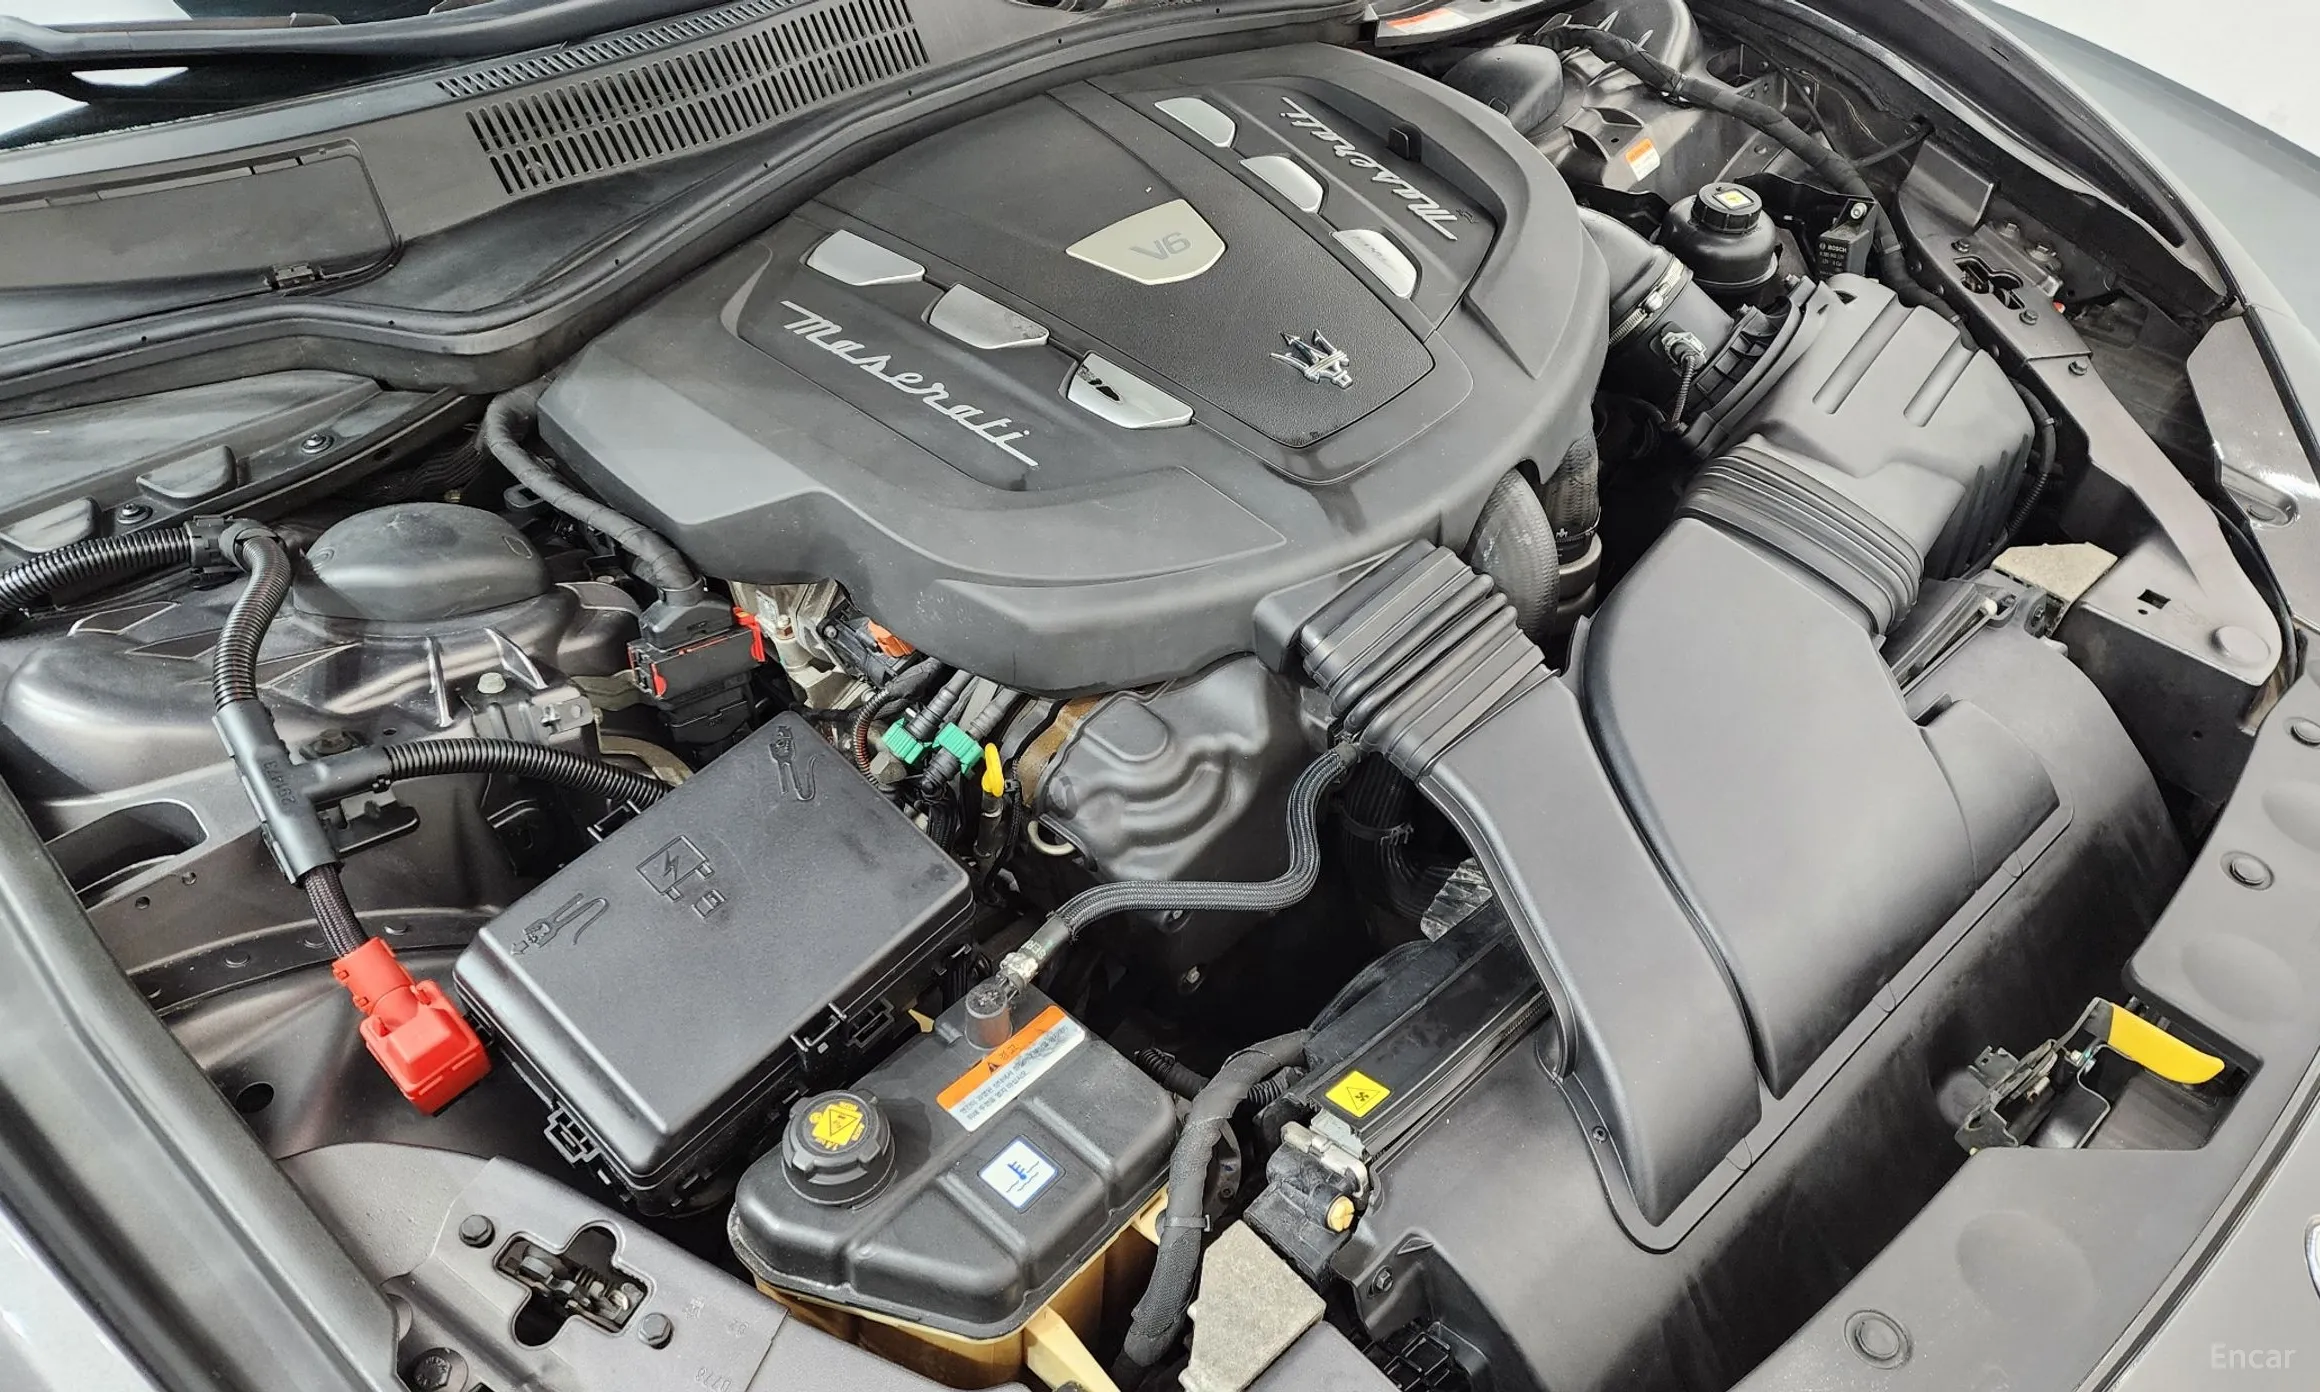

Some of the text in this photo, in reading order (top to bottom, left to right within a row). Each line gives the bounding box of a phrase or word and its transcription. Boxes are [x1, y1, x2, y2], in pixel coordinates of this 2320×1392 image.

[1280, 97, 1457, 241] Maserati
[1130, 232, 1191, 260] V6
[1827, 244, 1847, 254] BOSCH
[780, 300, 1039, 467] Maserati
